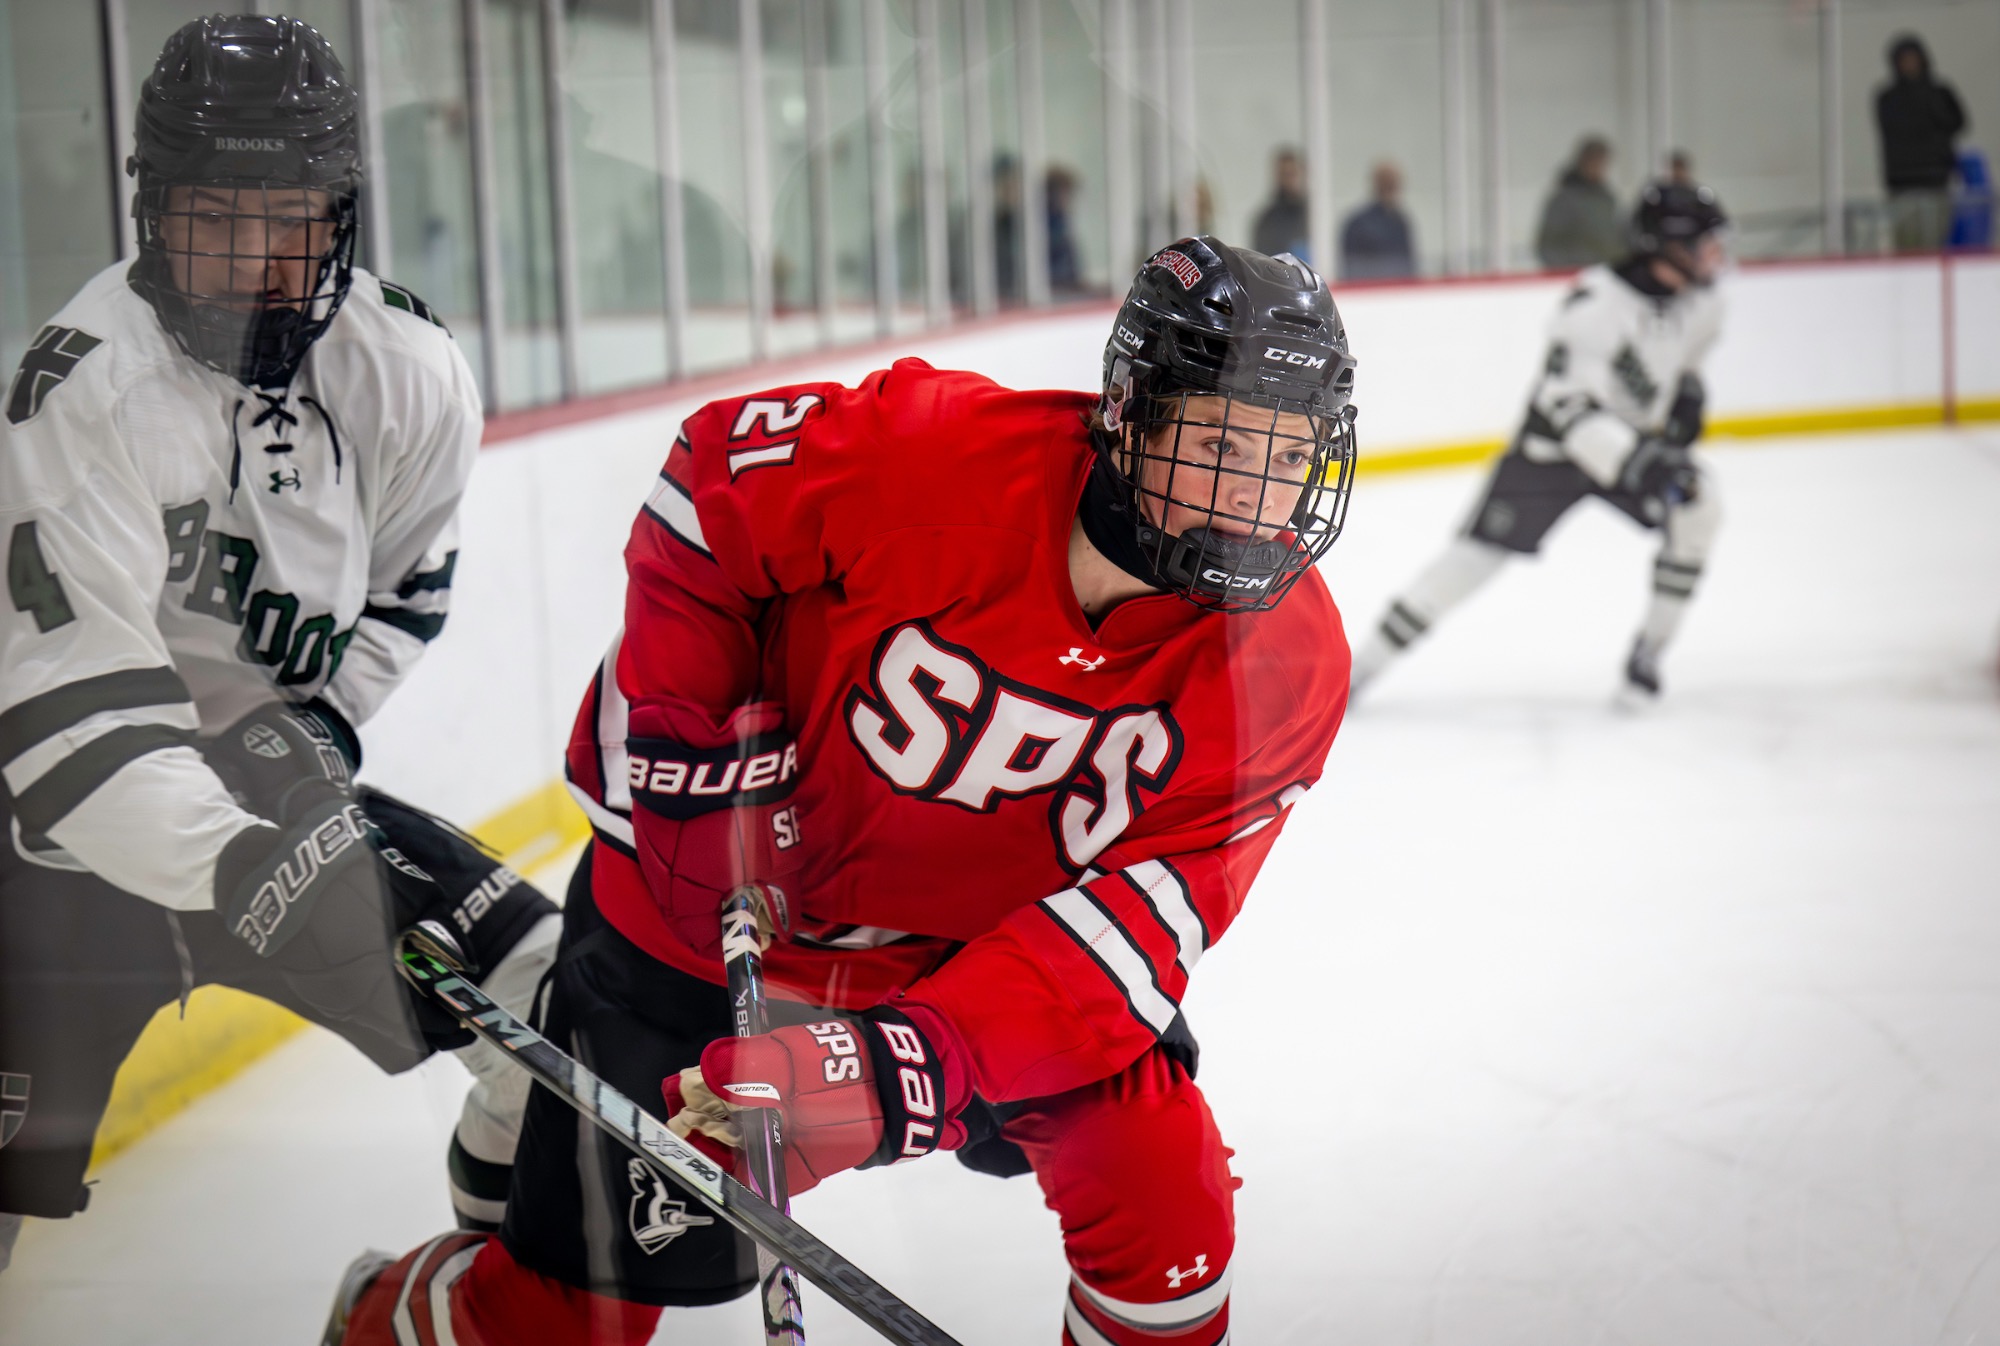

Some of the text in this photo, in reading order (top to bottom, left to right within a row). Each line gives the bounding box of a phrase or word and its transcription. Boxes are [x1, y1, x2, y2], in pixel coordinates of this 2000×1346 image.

[214, 136, 286, 152] BROOKS
[1117, 324, 1145, 350] CCM
[1263, 346, 1327, 370] CCM
[728, 393, 824, 484] 21
[7, 520, 77, 634] 4
[1202, 568, 1272, 590] CCM
[845, 619, 1183, 875] SPS
[402, 952, 542, 1051] CCM
[804, 1020, 863, 1084] SPS
[772, 1119, 782, 1146] FLEX
[685, 1158, 718, 1182] PRO
